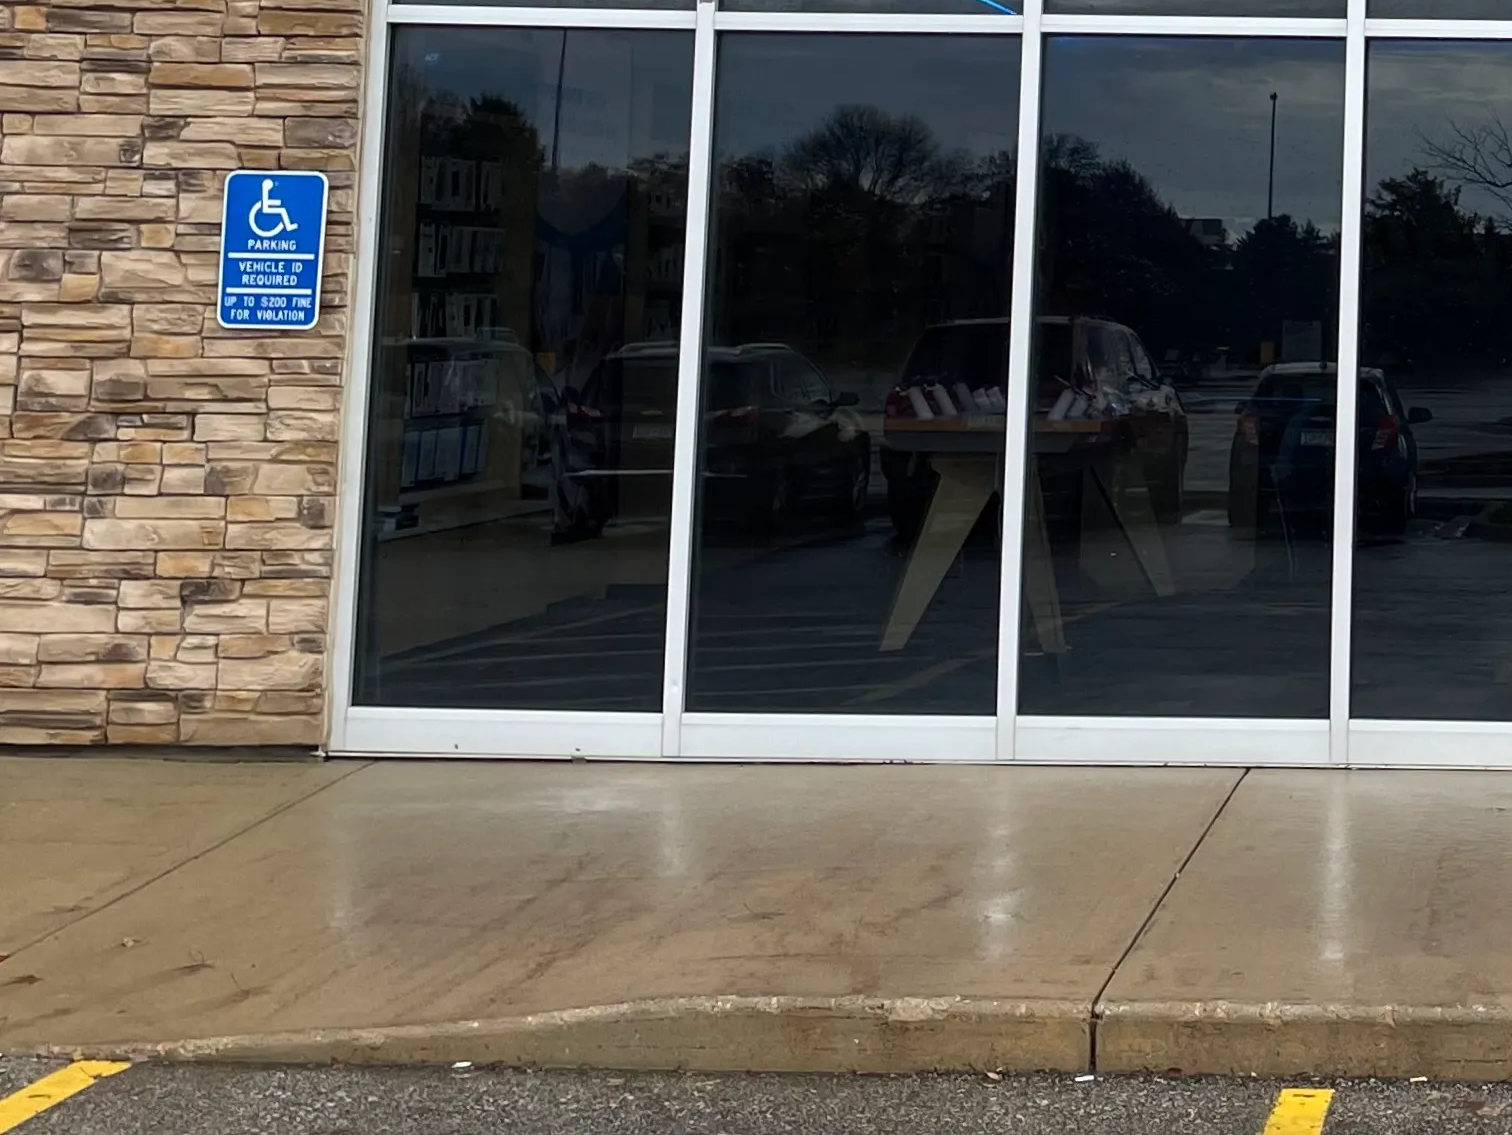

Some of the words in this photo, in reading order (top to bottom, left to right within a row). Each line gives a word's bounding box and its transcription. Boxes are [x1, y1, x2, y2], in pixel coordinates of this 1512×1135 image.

[247, 239, 296, 251] PARKING
[239, 261, 285, 273] VEHICLE
[291, 262, 303, 273] ID
[241, 275, 298, 286] REQUIRED
[224, 296, 237, 306] UP
[243, 296, 255, 307] TO
[260, 296, 287, 308] $200
[292, 297, 312, 308] FINE
[230, 309, 250, 321] FOR
[256, 310, 305, 322] VIOLATION
